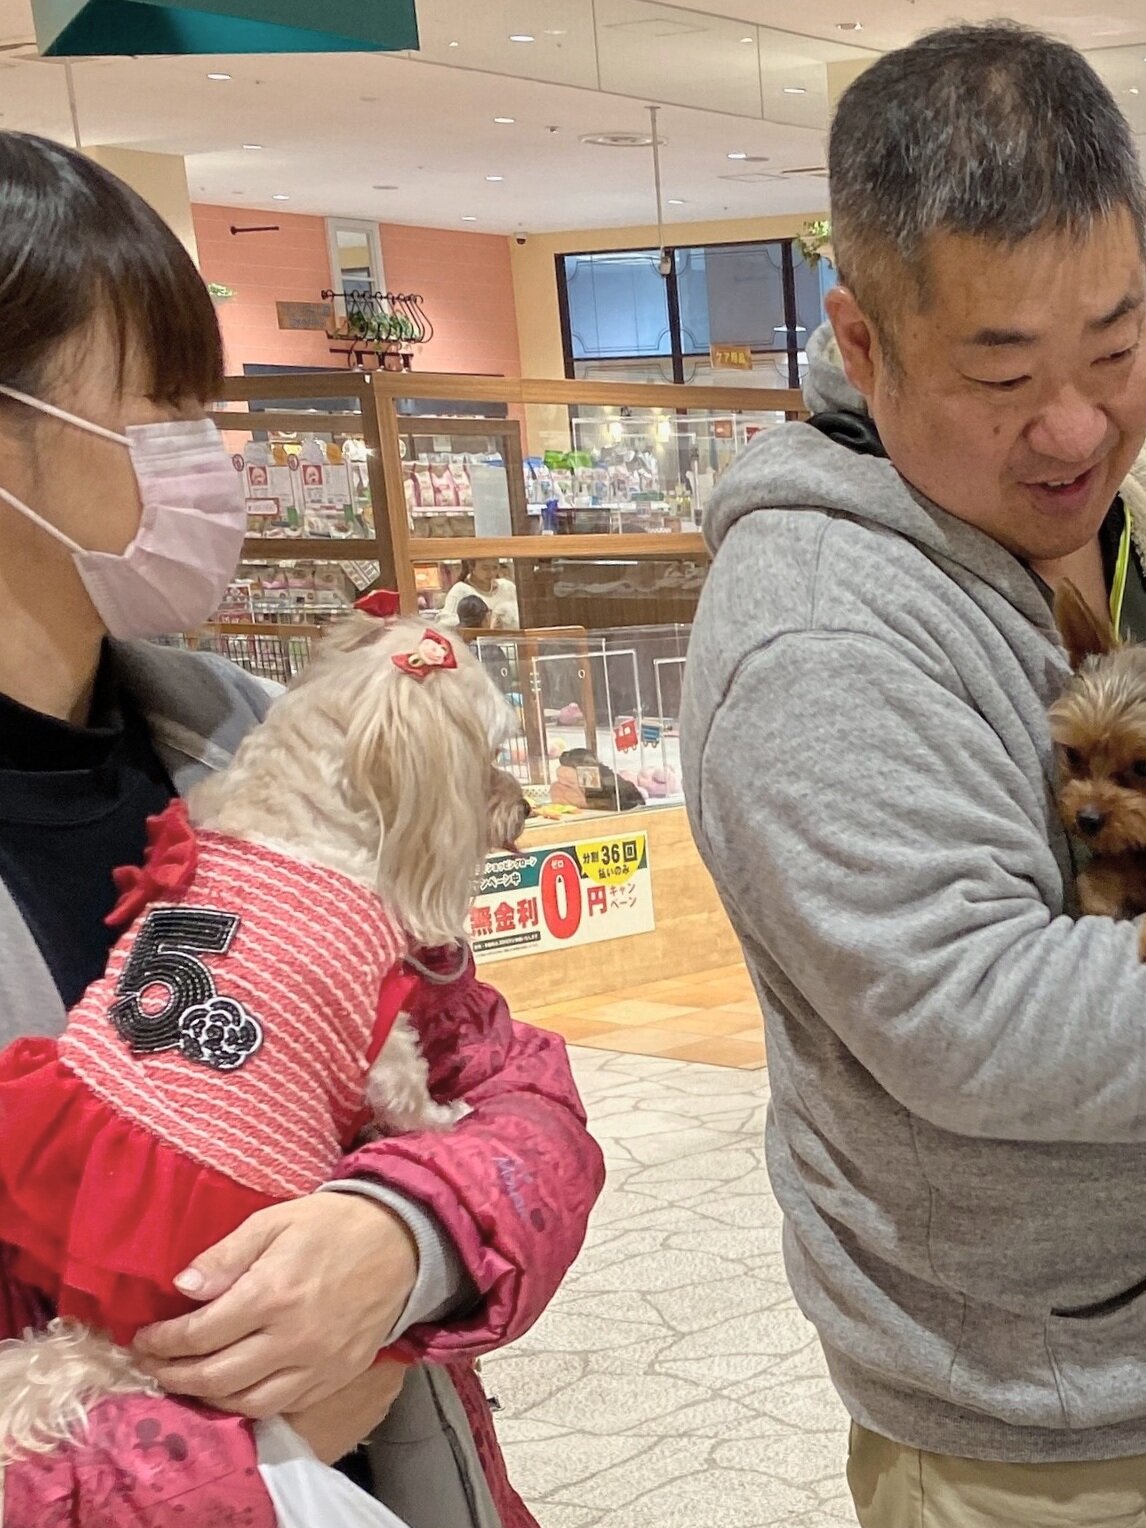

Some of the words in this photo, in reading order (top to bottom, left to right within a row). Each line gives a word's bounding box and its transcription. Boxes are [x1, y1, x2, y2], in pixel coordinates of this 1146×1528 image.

[609, 883, 636, 896] キャン
[610, 897, 637, 909] ペーン
[109, 907, 240, 1052] 5
